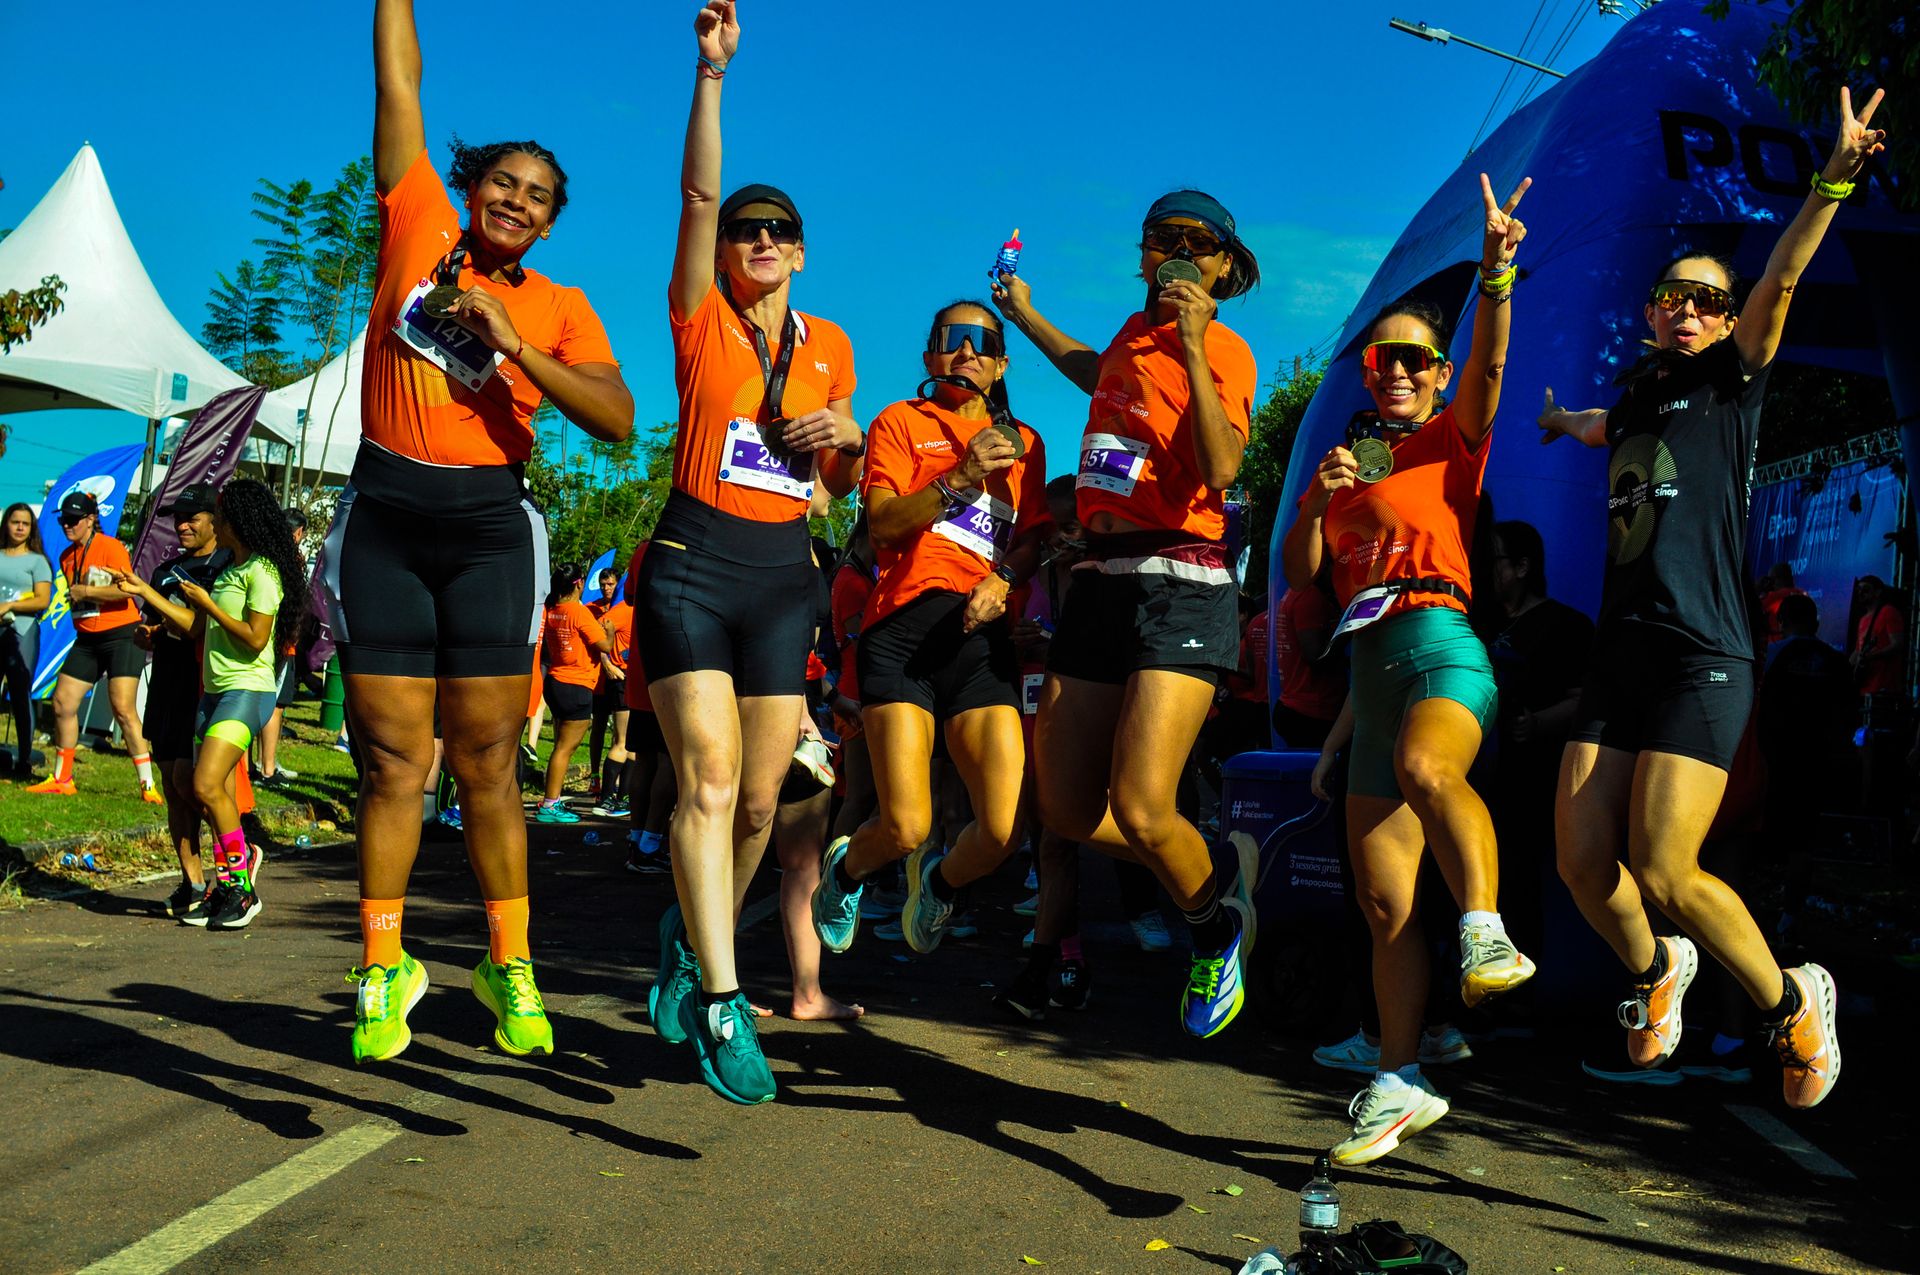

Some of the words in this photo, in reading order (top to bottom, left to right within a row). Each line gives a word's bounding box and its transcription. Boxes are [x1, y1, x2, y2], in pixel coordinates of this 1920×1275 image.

[1129, 404, 1149, 418] Sinop
[1658, 400, 1689, 415] LILIAN
[1081, 449, 1109, 468] 451
[1654, 487, 1679, 497] Sinop
[969, 511, 1002, 538] 461
[1388, 545, 1410, 555] Sinop
[369, 919, 399, 931] RUN
